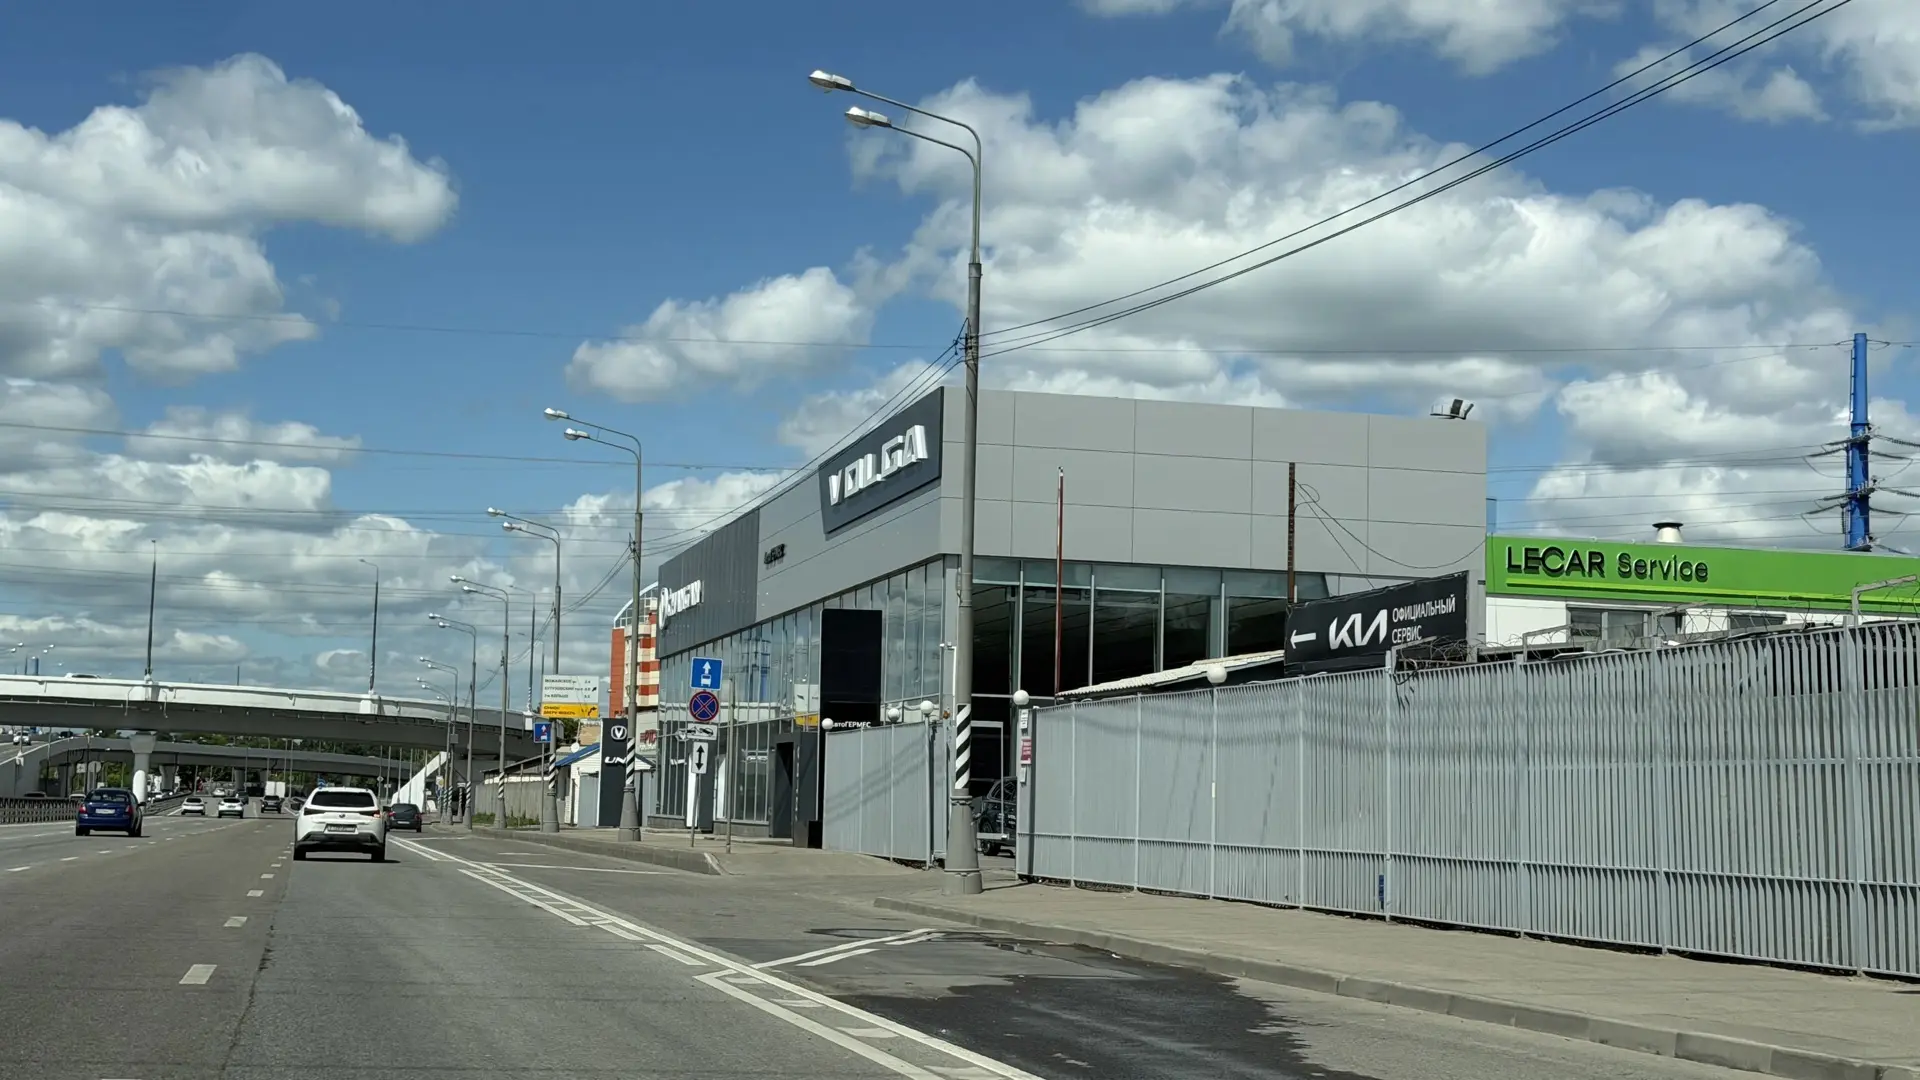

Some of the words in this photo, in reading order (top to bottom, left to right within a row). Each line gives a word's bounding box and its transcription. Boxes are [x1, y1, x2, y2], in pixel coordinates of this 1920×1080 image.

[829, 425, 928, 506] VOLGA
[1506, 546, 1605, 577] LECAR
[1616, 552, 1708, 582] Service
[1392, 594, 1456, 623] ОФИЦИАЛЬНЫЙ
[1391, 625, 1422, 644] СЕРВИС
